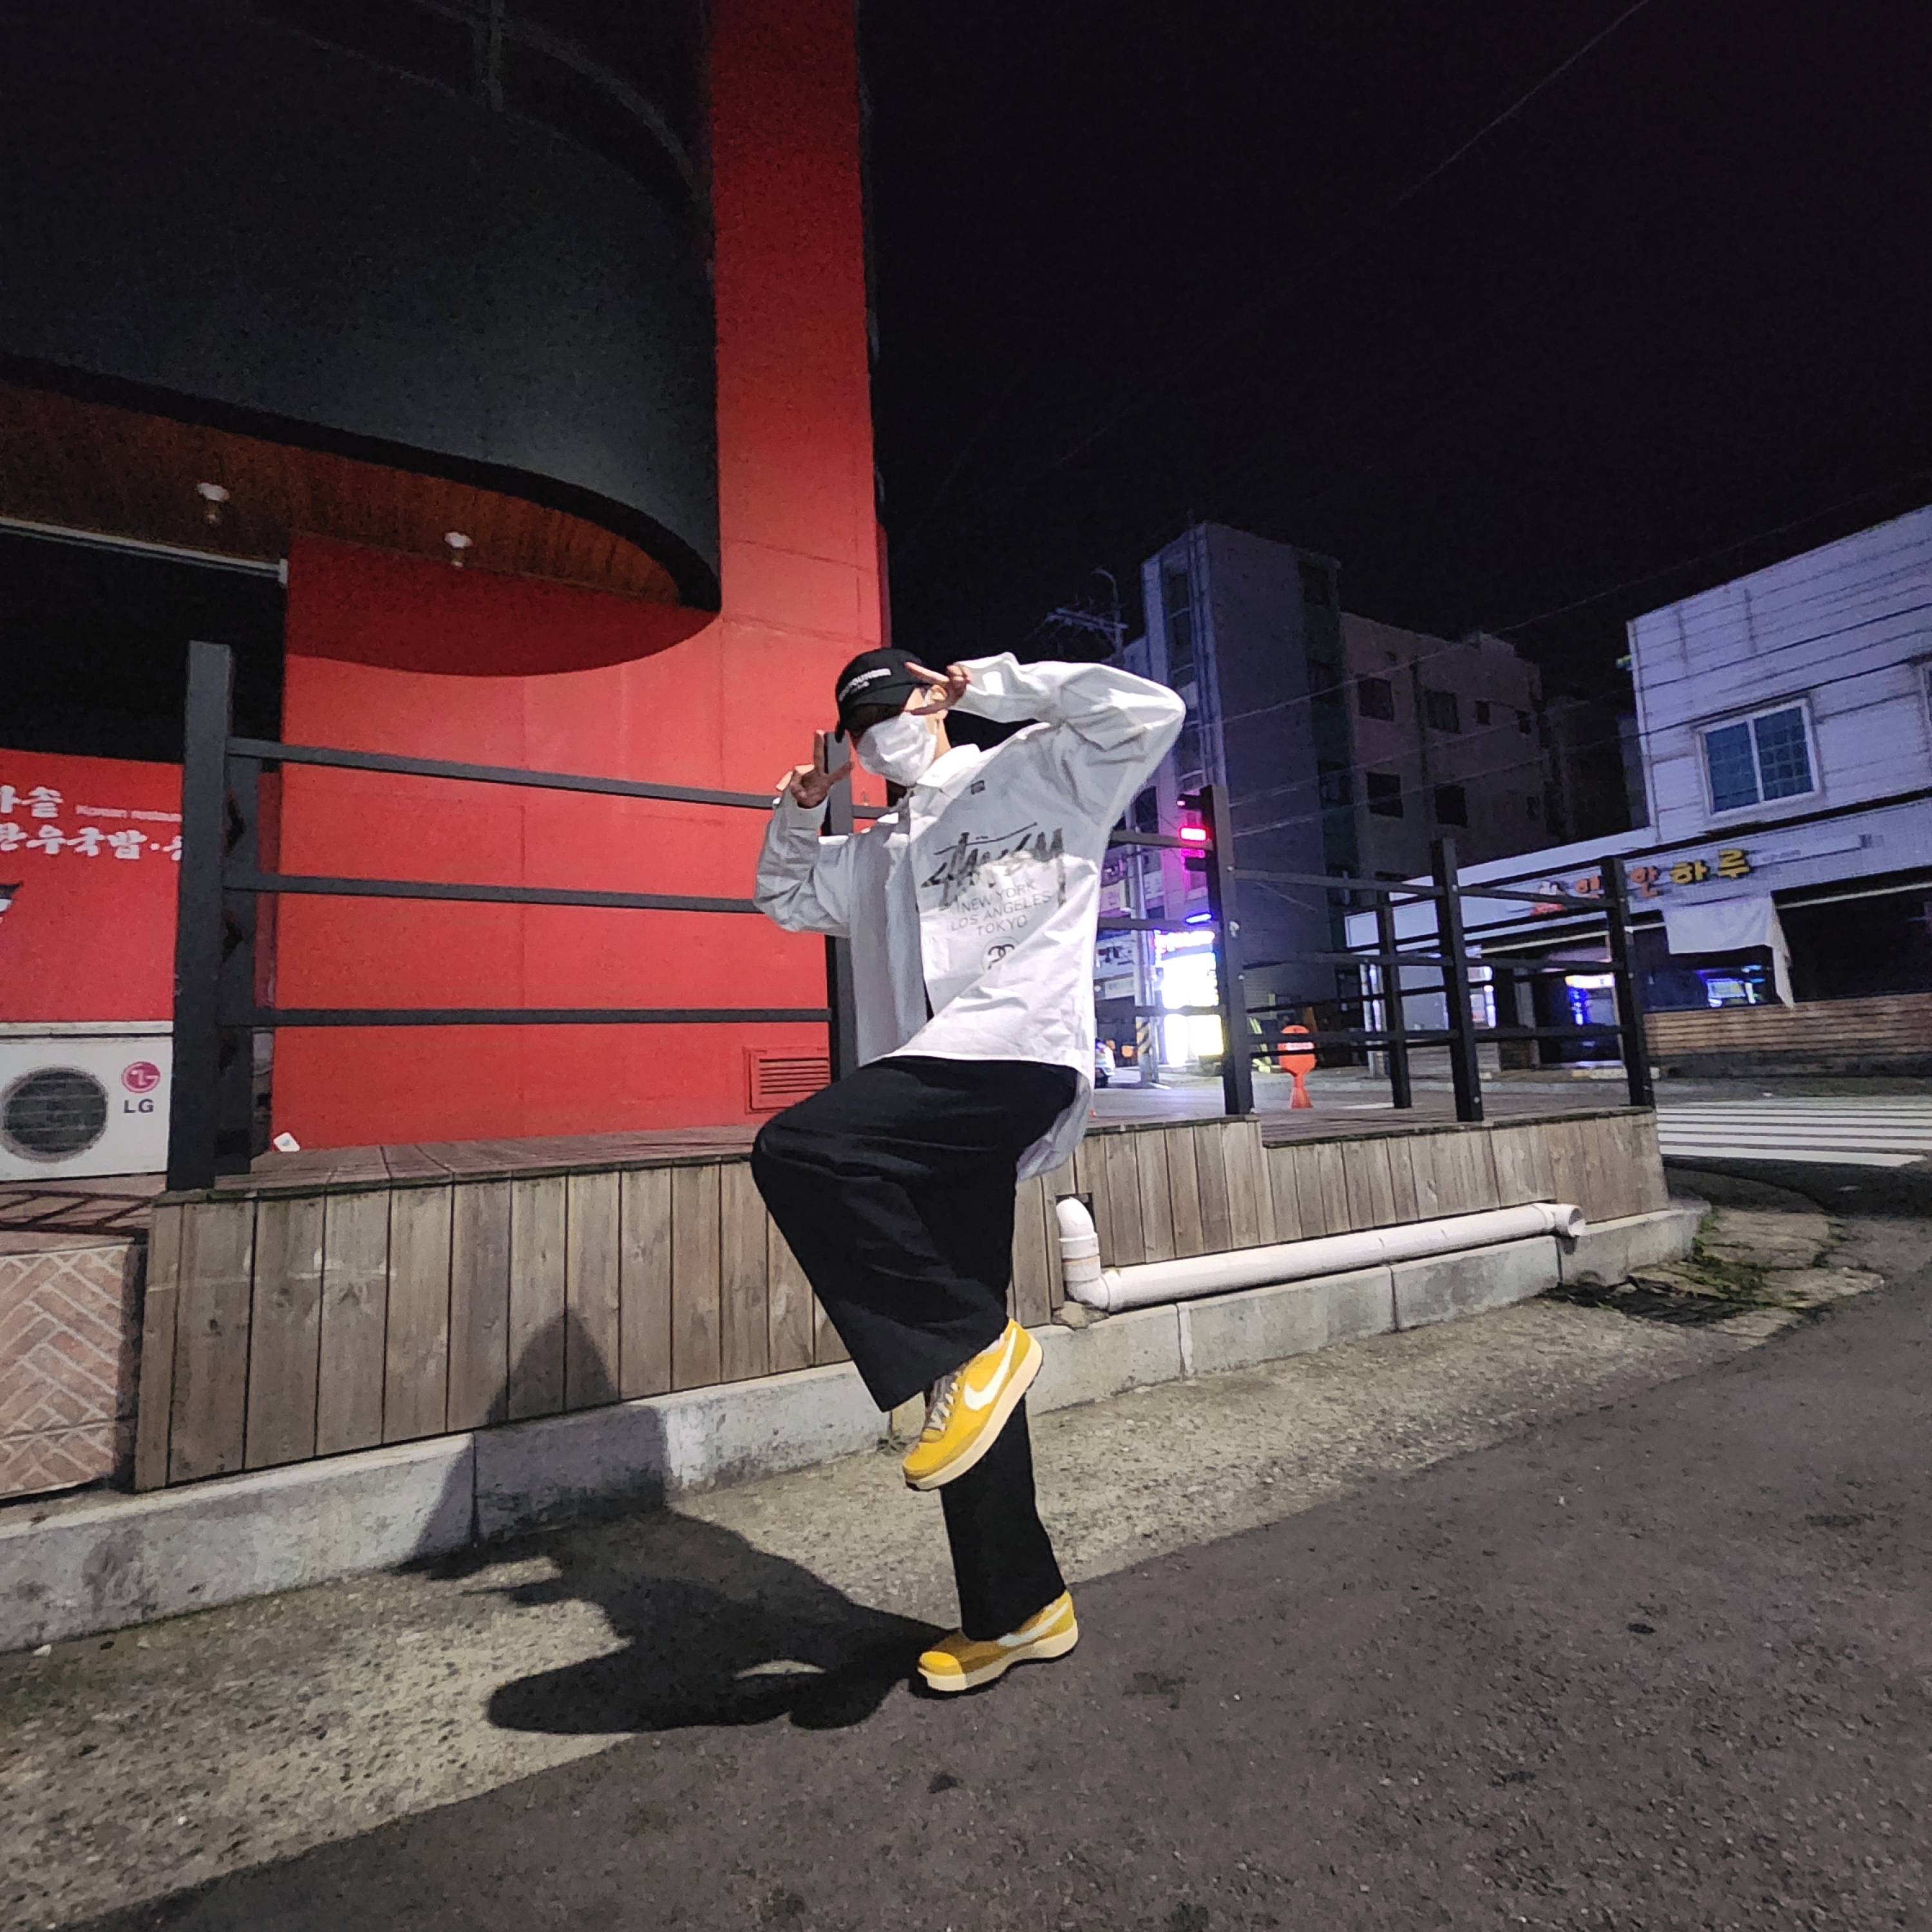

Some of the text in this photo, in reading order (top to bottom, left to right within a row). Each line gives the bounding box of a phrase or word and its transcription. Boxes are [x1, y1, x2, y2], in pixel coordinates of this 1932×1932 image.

[961, 878, 1037, 913] NEW YORK
[950, 890, 1052, 931] LOS ANGELES
[976, 914, 1028, 936] TOKYO
[123, 1099, 154, 1113] LG
